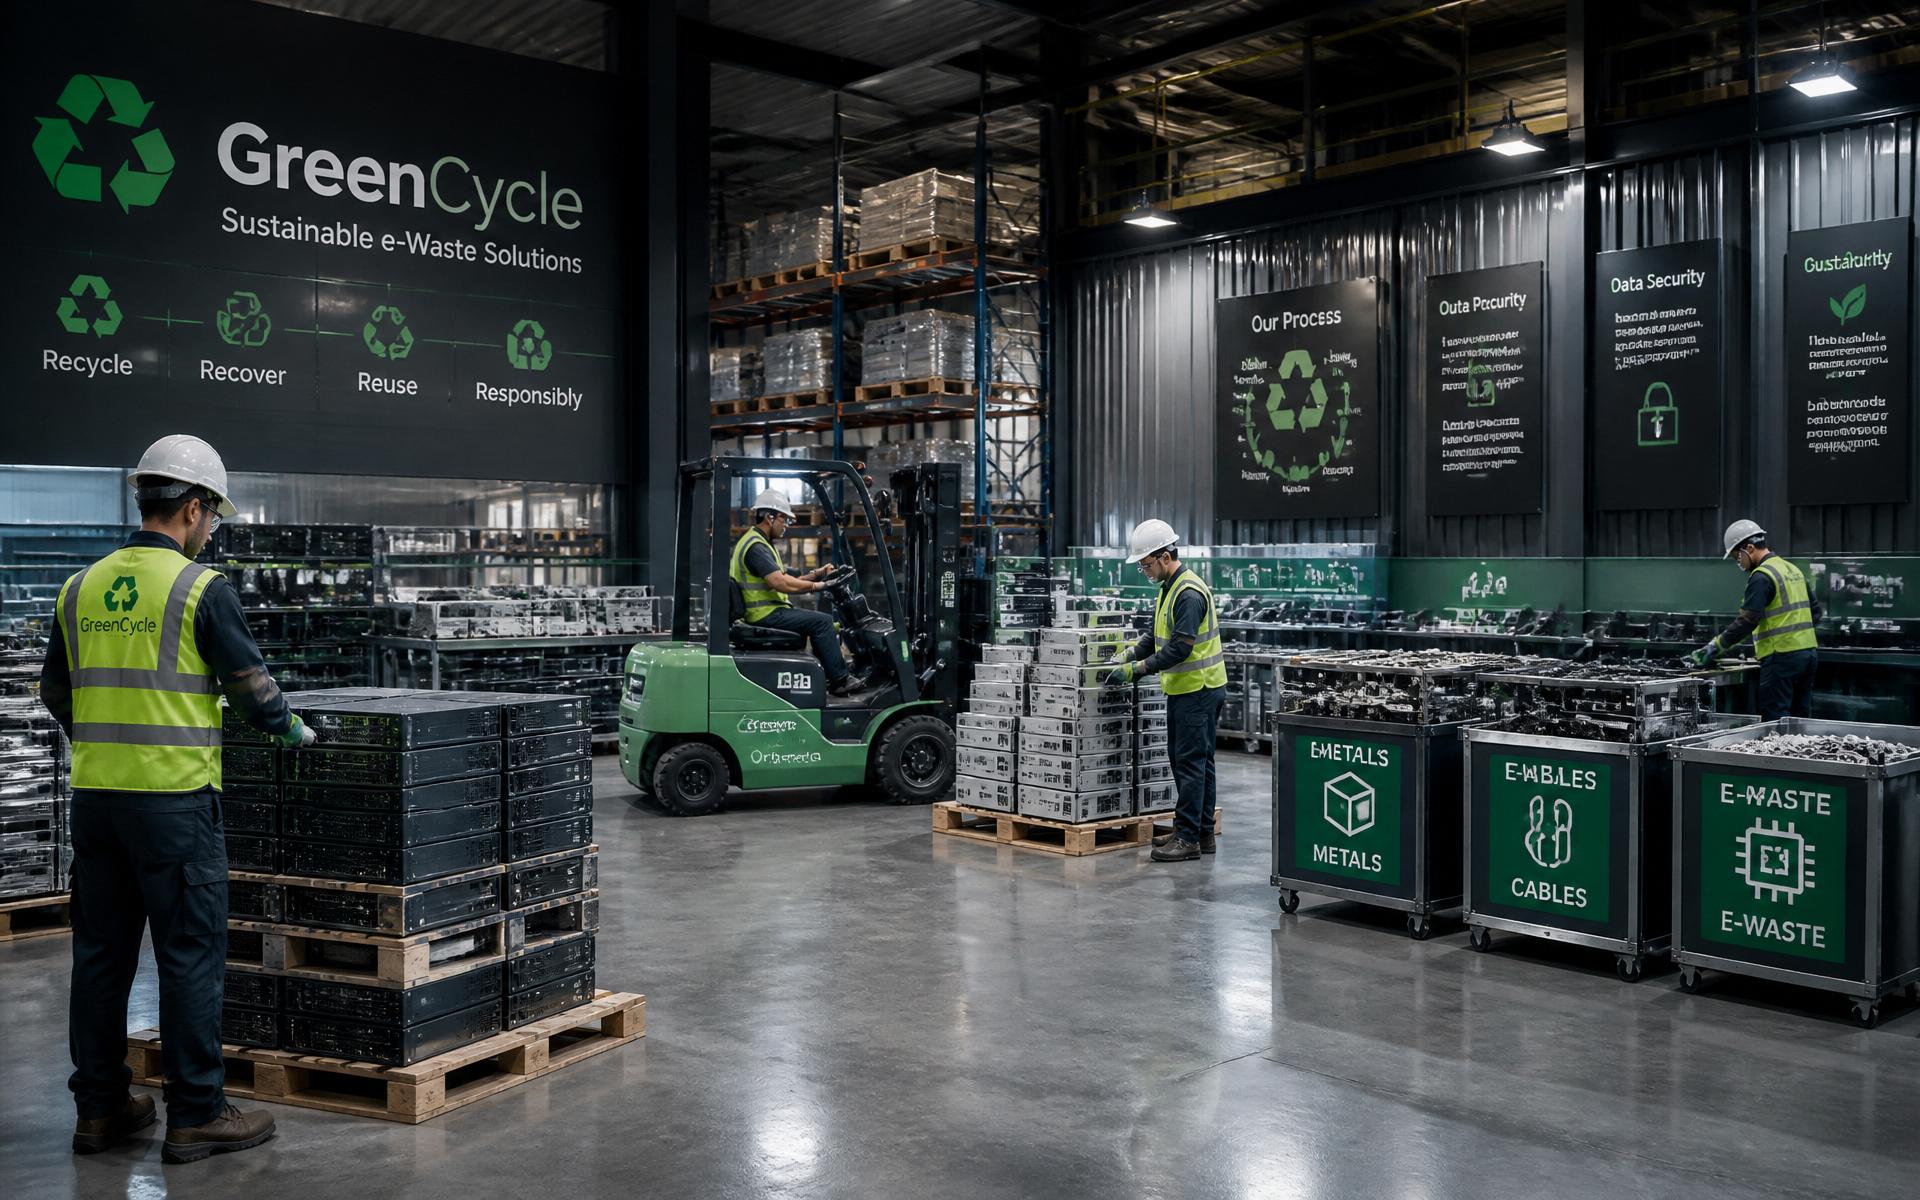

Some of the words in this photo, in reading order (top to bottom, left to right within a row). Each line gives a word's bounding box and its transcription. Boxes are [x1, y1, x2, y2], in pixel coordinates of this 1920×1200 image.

[217, 121, 583, 231] GreenCycle
[221, 207, 374, 249] Sustainable
[381, 230, 477, 262] e-Waste
[484, 242, 582, 274] Solutions
[1647, 269, 1705, 289] Security
[1251, 314, 1279, 333] Our
[1283, 309, 1342, 331] Process
[42, 349, 133, 378] Recycle
[200, 360, 287, 386] Recover
[358, 372, 418, 396] Reuse
[475, 382, 583, 411] Responsibly
[80, 616, 157, 636] GreenCycle
[1313, 843, 1382, 872] METALS
[1511, 877, 1587, 908] CABLES
[1721, 910, 1826, 949] E-WASTE
